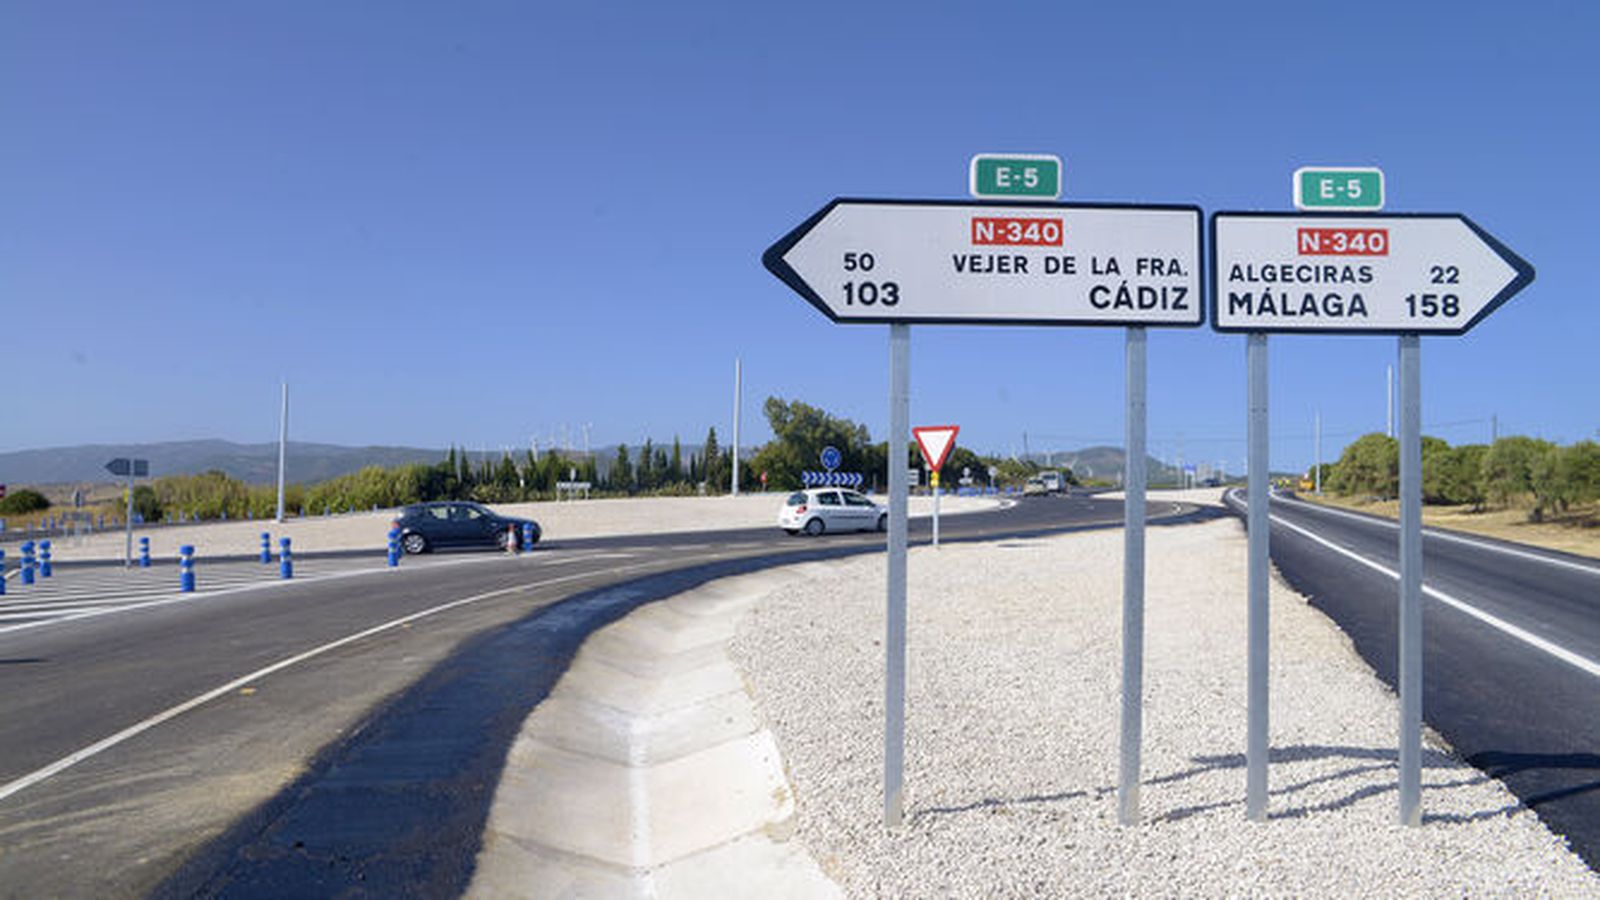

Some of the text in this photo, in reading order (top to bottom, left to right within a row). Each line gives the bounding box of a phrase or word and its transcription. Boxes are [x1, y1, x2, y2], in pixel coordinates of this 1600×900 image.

[996, 167, 1038, 188] E-5
[1320, 179, 1362, 199] E-5
[974, 221, 1060, 244] N-340
[1301, 232, 1385, 252] N-340
[843, 253, 1189, 277] 50 VEJER DE LA FRA.
[1228, 264, 1459, 284] ALGECIRAS 22
[842, 280, 1189, 311] 103 CÁDIZ
[1228, 287, 1460, 317] MÁLAGA 158
